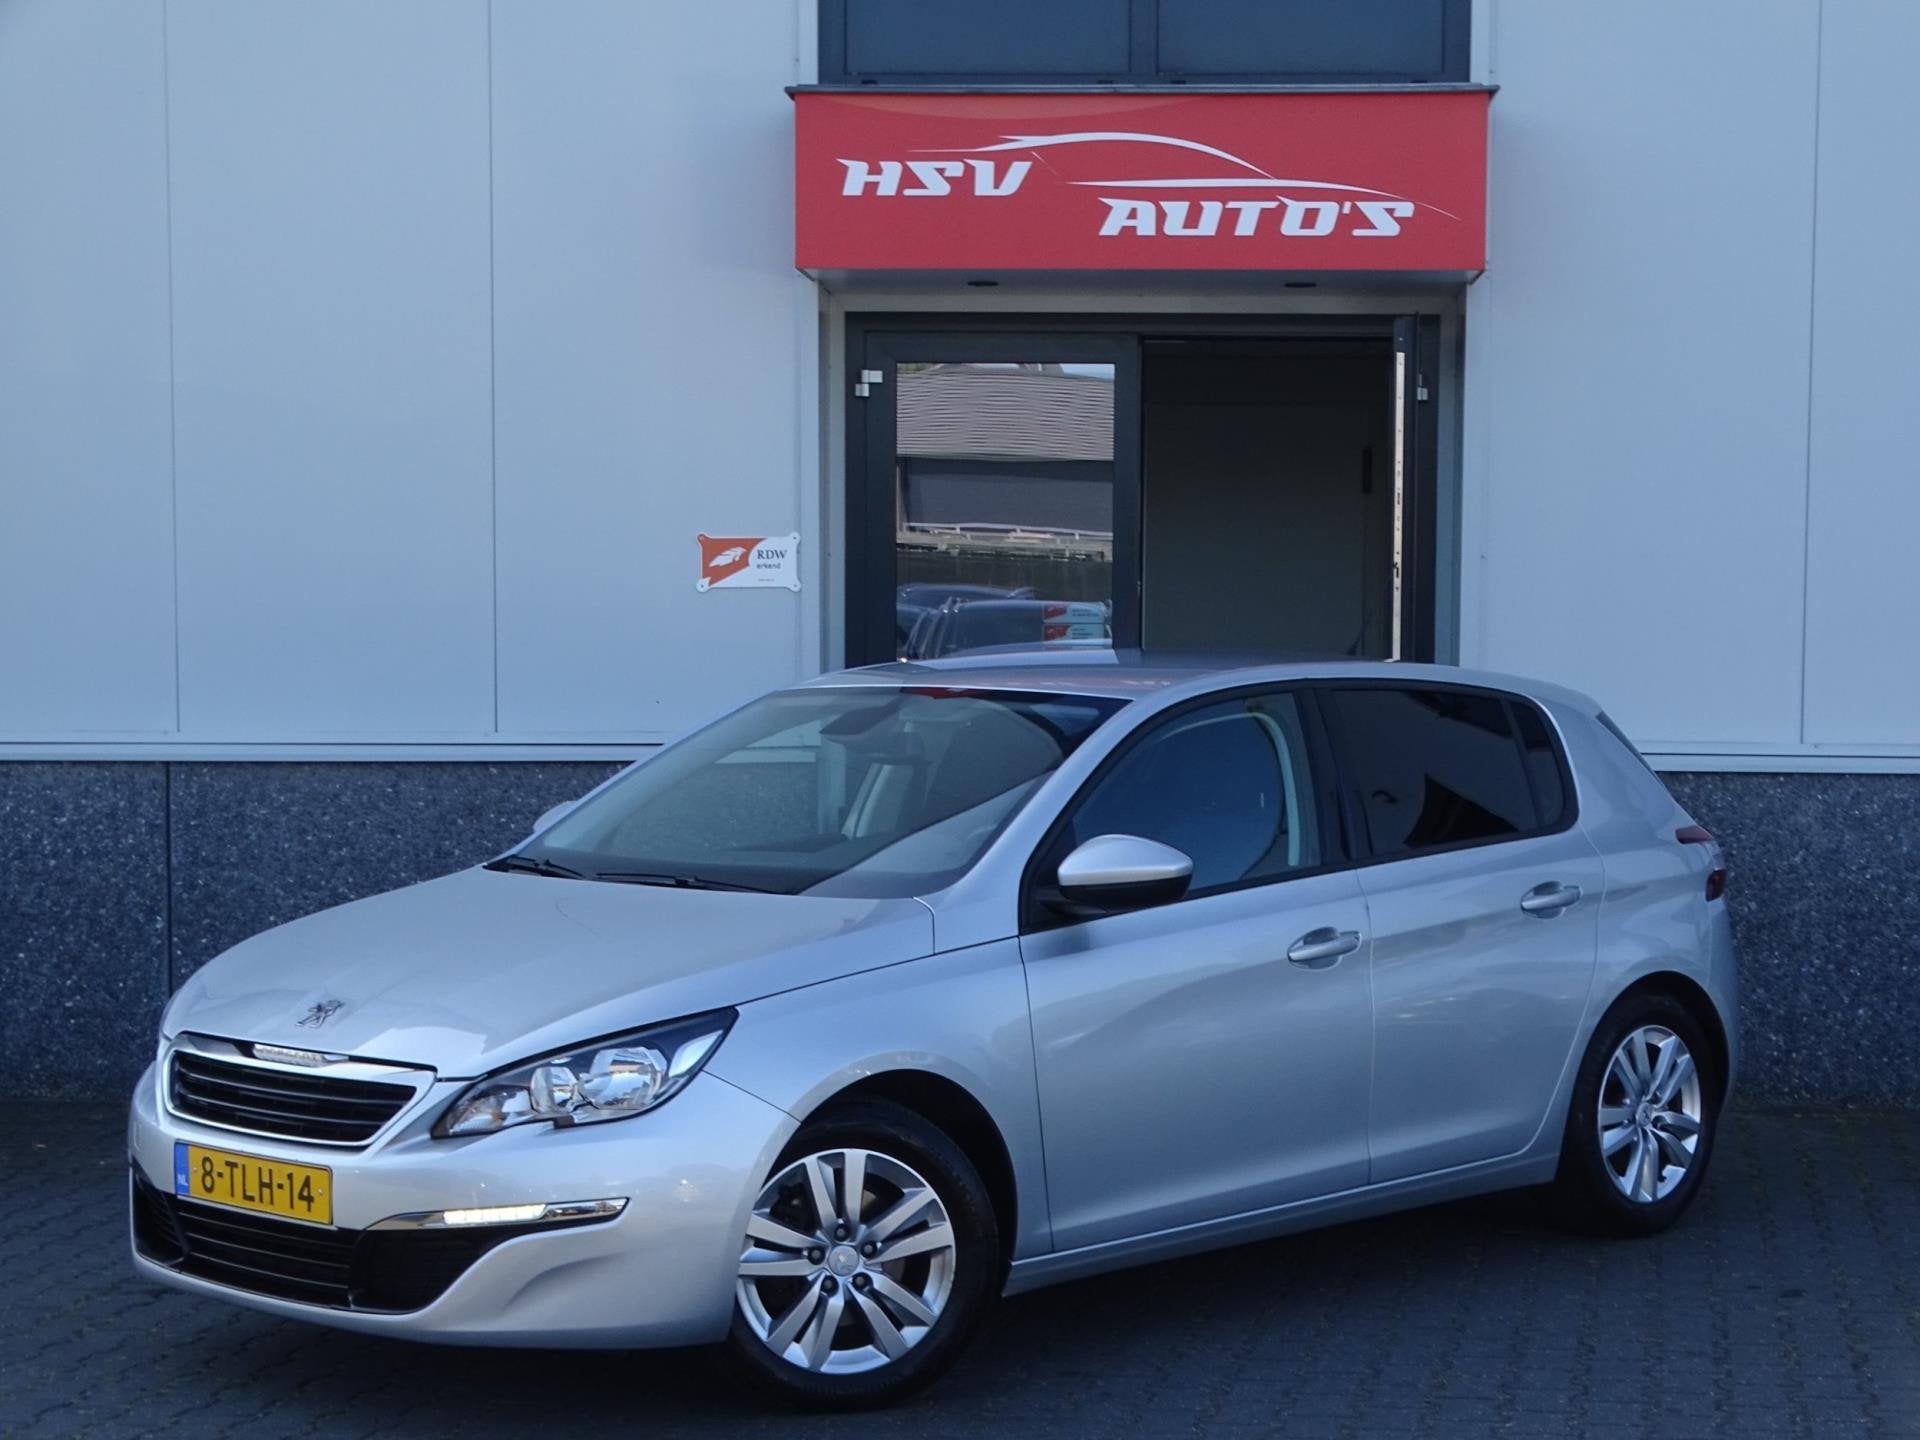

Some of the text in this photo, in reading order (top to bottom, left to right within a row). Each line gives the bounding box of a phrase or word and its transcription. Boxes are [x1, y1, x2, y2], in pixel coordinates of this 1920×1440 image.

[837, 157, 1033, 197] HSV
[1098, 195, 1416, 237] AUTO'S
[757, 549, 787, 560] RDW
[201, 1156, 314, 1213] 8-TLH-14
